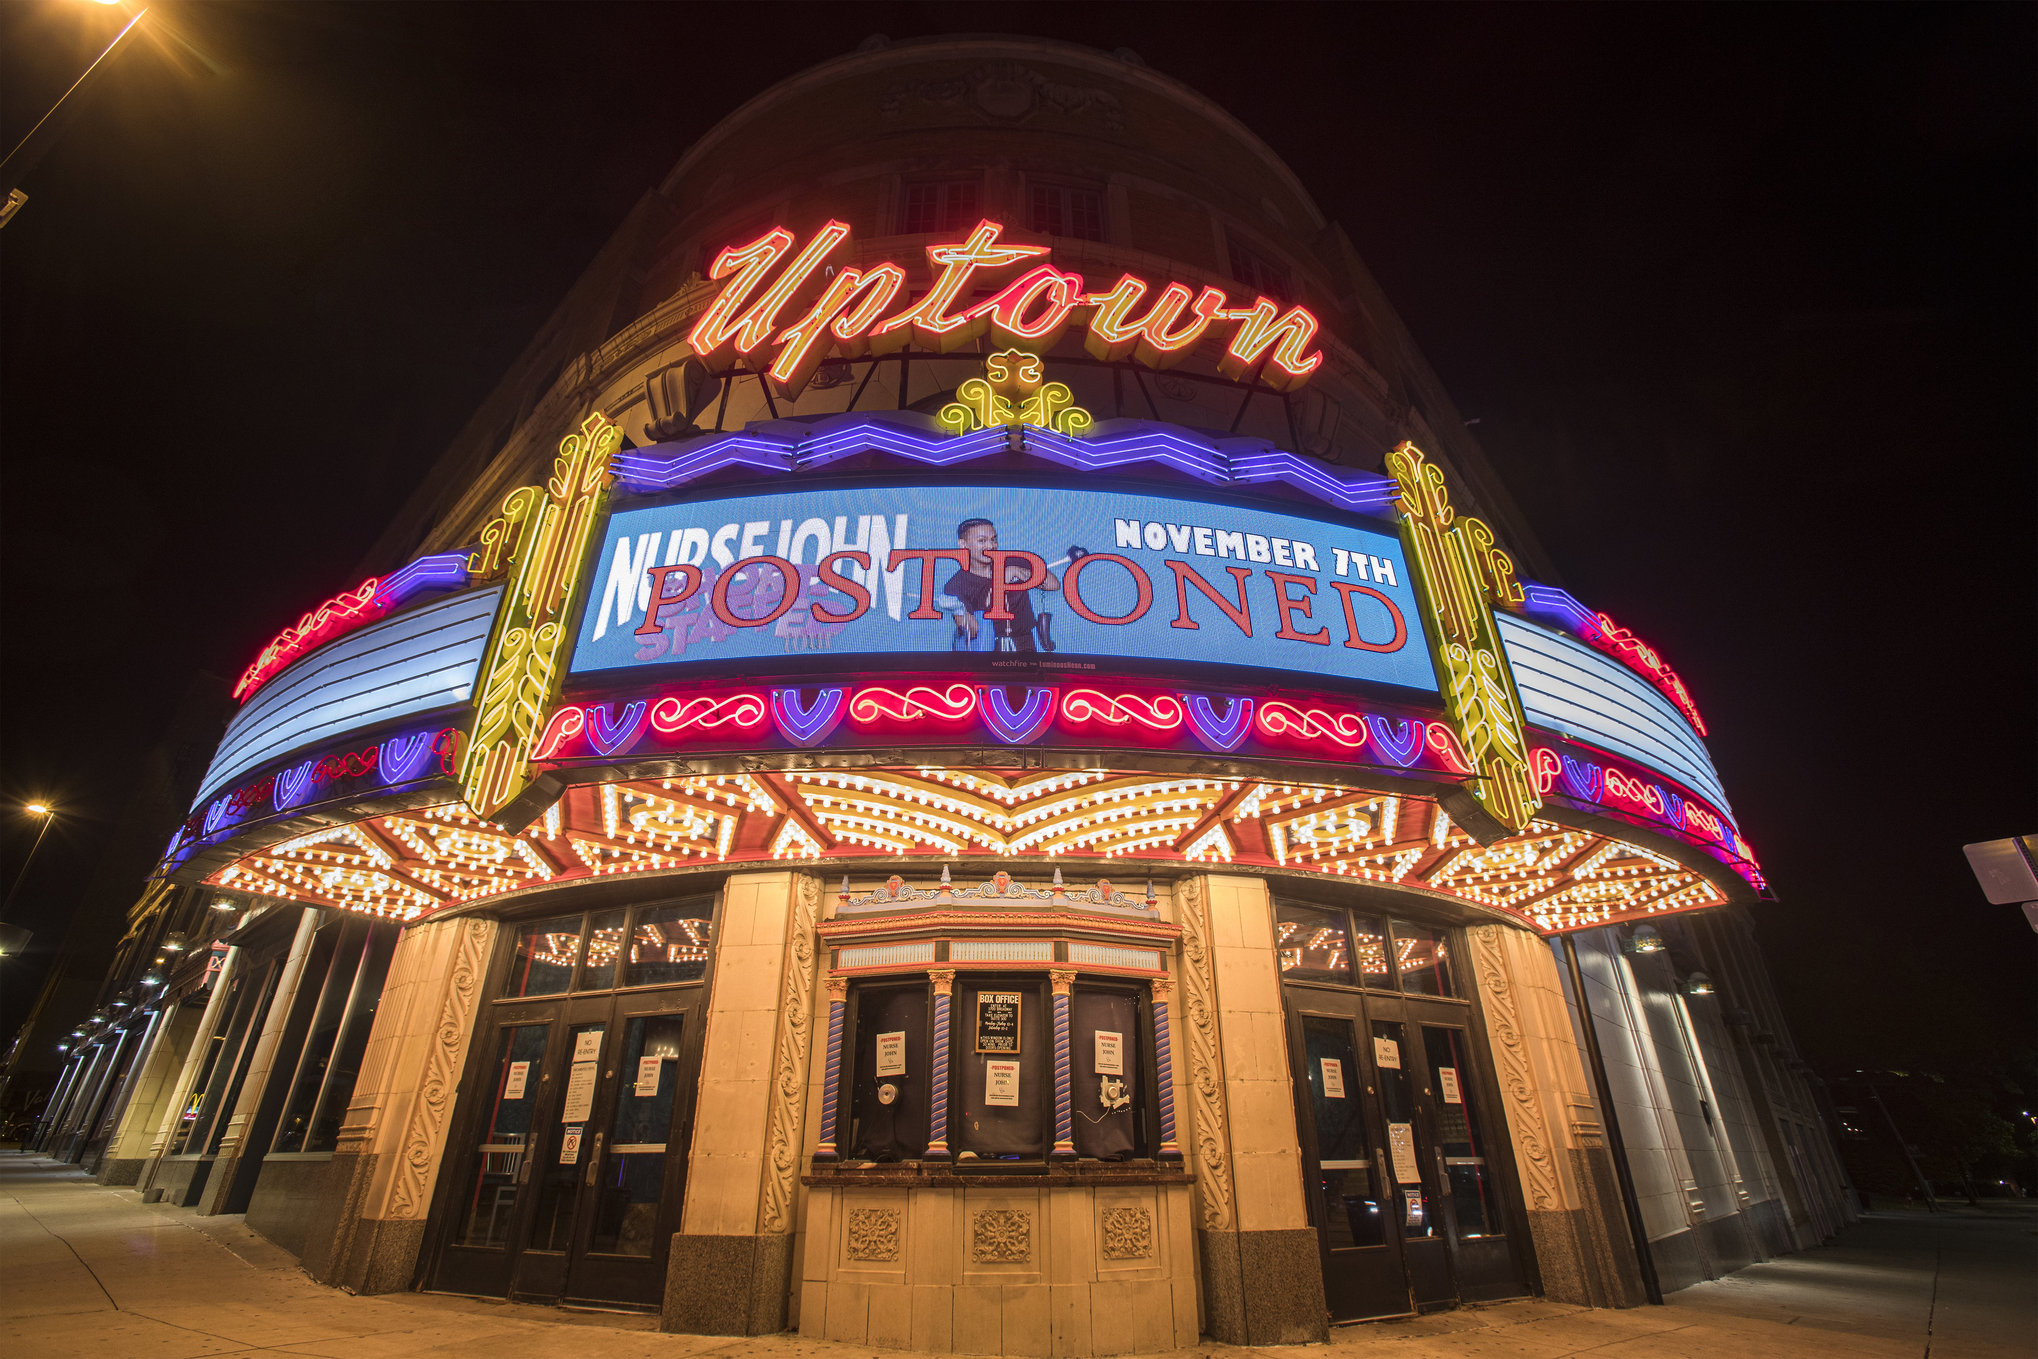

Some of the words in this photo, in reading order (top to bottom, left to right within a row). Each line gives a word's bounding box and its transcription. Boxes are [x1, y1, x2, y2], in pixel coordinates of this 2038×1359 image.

[687, 219, 1323, 382] Uptown
[1114, 518, 1320, 572] NOVEMBER
[1330, 547, 1398, 587] 7TH
[634, 548, 1408, 653] POSTPONED
[991, 659, 1028, 668] watchfire
[980, 994, 994, 1003] BOX
[996, 995, 1019, 1004] OFFICE
